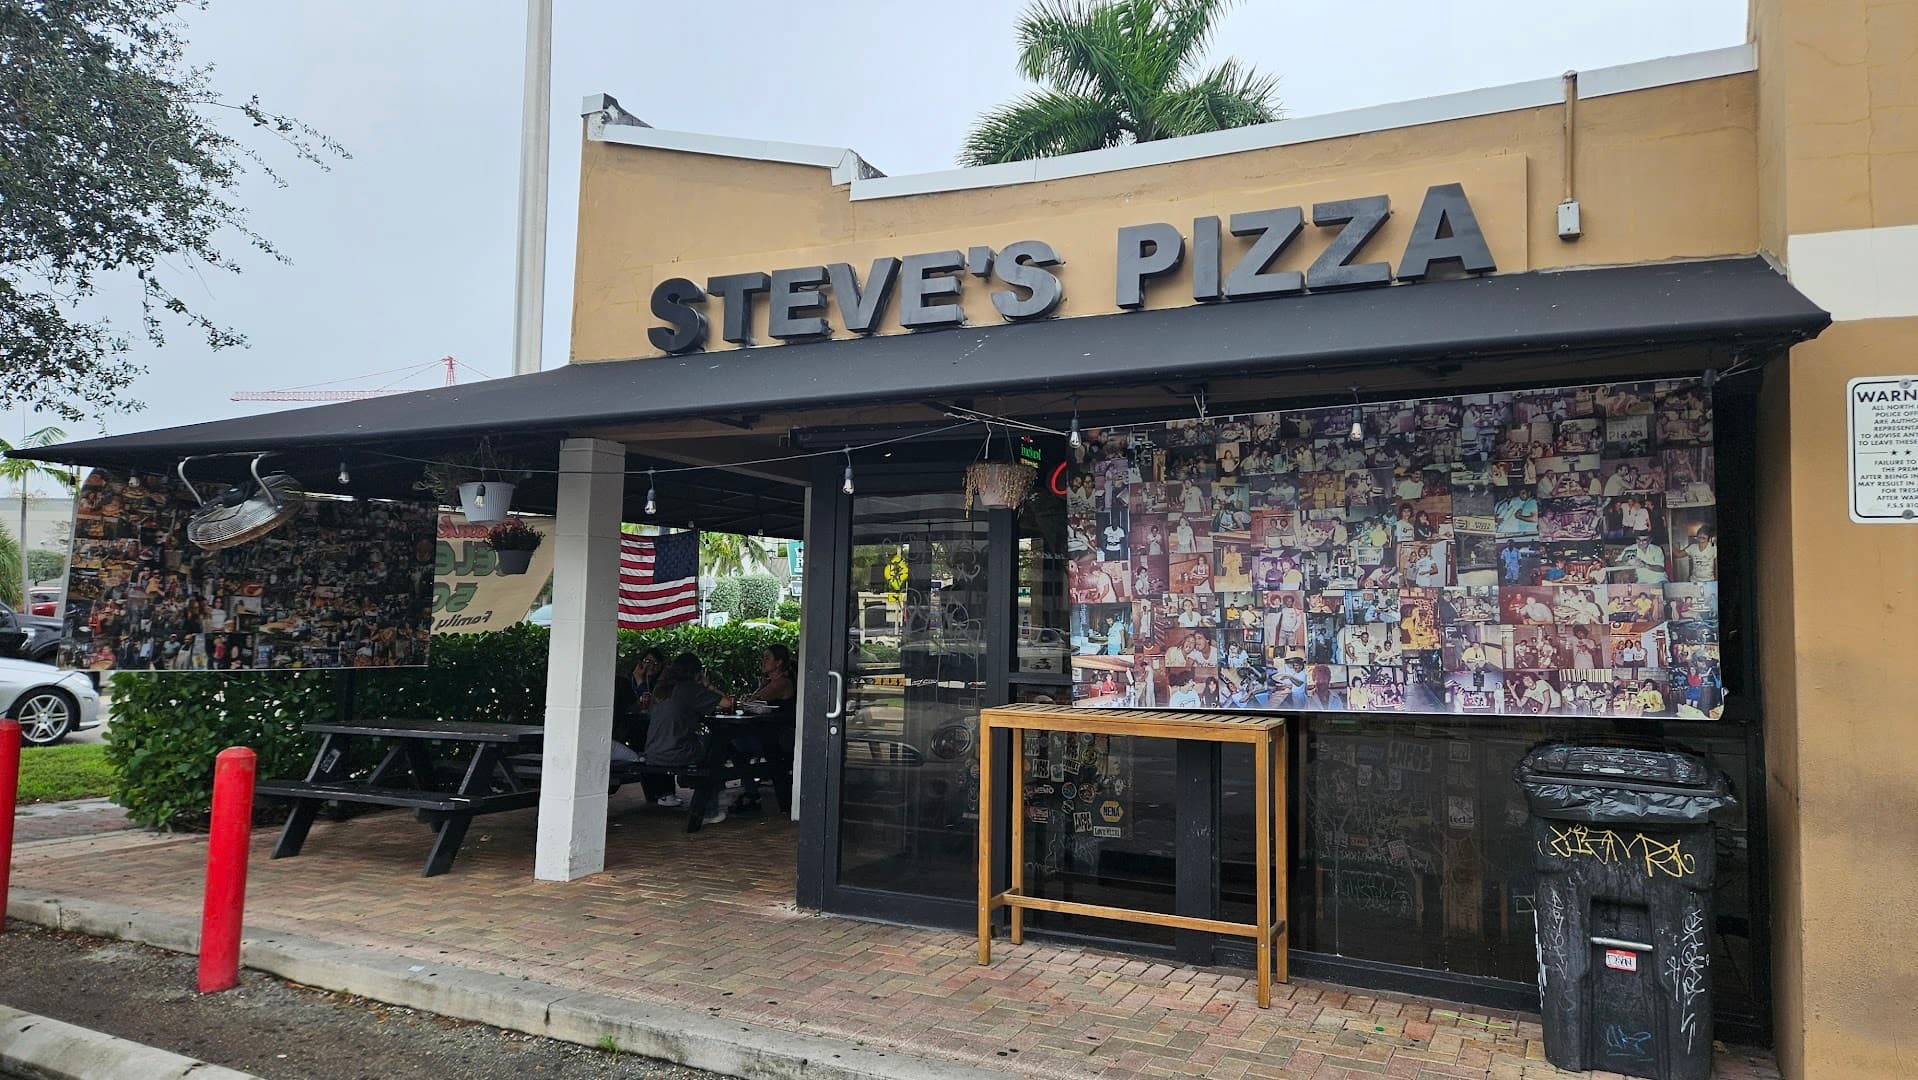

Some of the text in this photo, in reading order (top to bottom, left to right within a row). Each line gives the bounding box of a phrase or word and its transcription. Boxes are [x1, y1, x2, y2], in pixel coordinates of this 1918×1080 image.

[648, 182, 1498, 356] STEVE'S PIZZA
[1857, 389, 1917, 402] WARN
